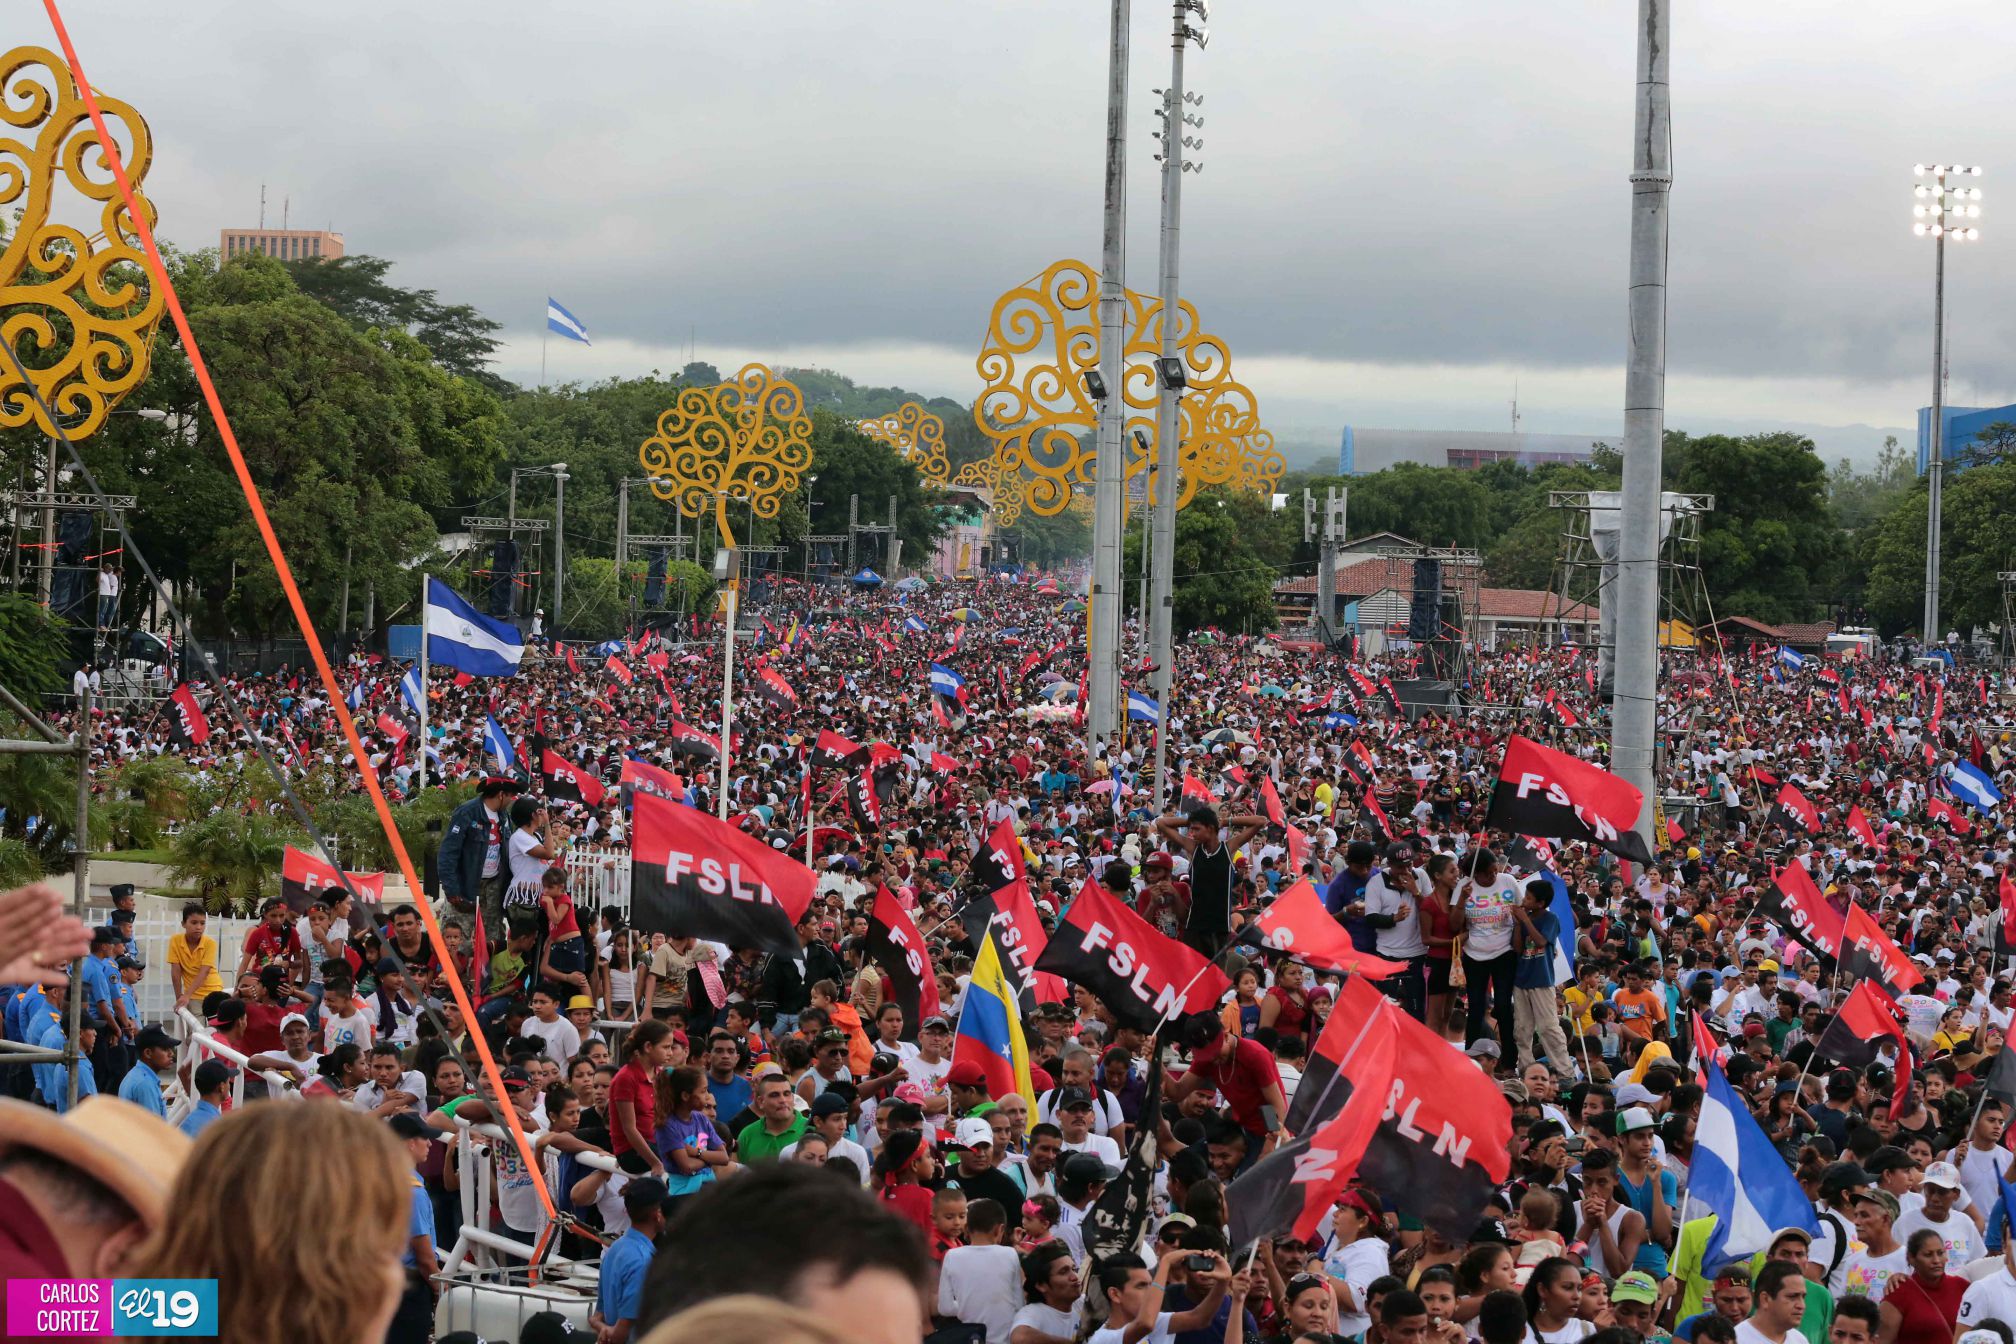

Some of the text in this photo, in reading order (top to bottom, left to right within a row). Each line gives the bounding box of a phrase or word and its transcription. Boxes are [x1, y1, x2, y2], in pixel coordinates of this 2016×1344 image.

[765, 678, 793, 699] FSLN
[1818, 674, 1836, 684] FSLN
[174, 701, 195, 737] FSLN
[857, 778, 876, 823] FSLN
[304, 872, 376, 904] FSN
[1780, 893, 1834, 954] FSLN
[993, 911, 1037, 987] FSLN
[1854, 935, 1899, 984] FSLN
[1080, 921, 1187, 1021] FSLN
[1960, 1301, 1972, 1318] 3
